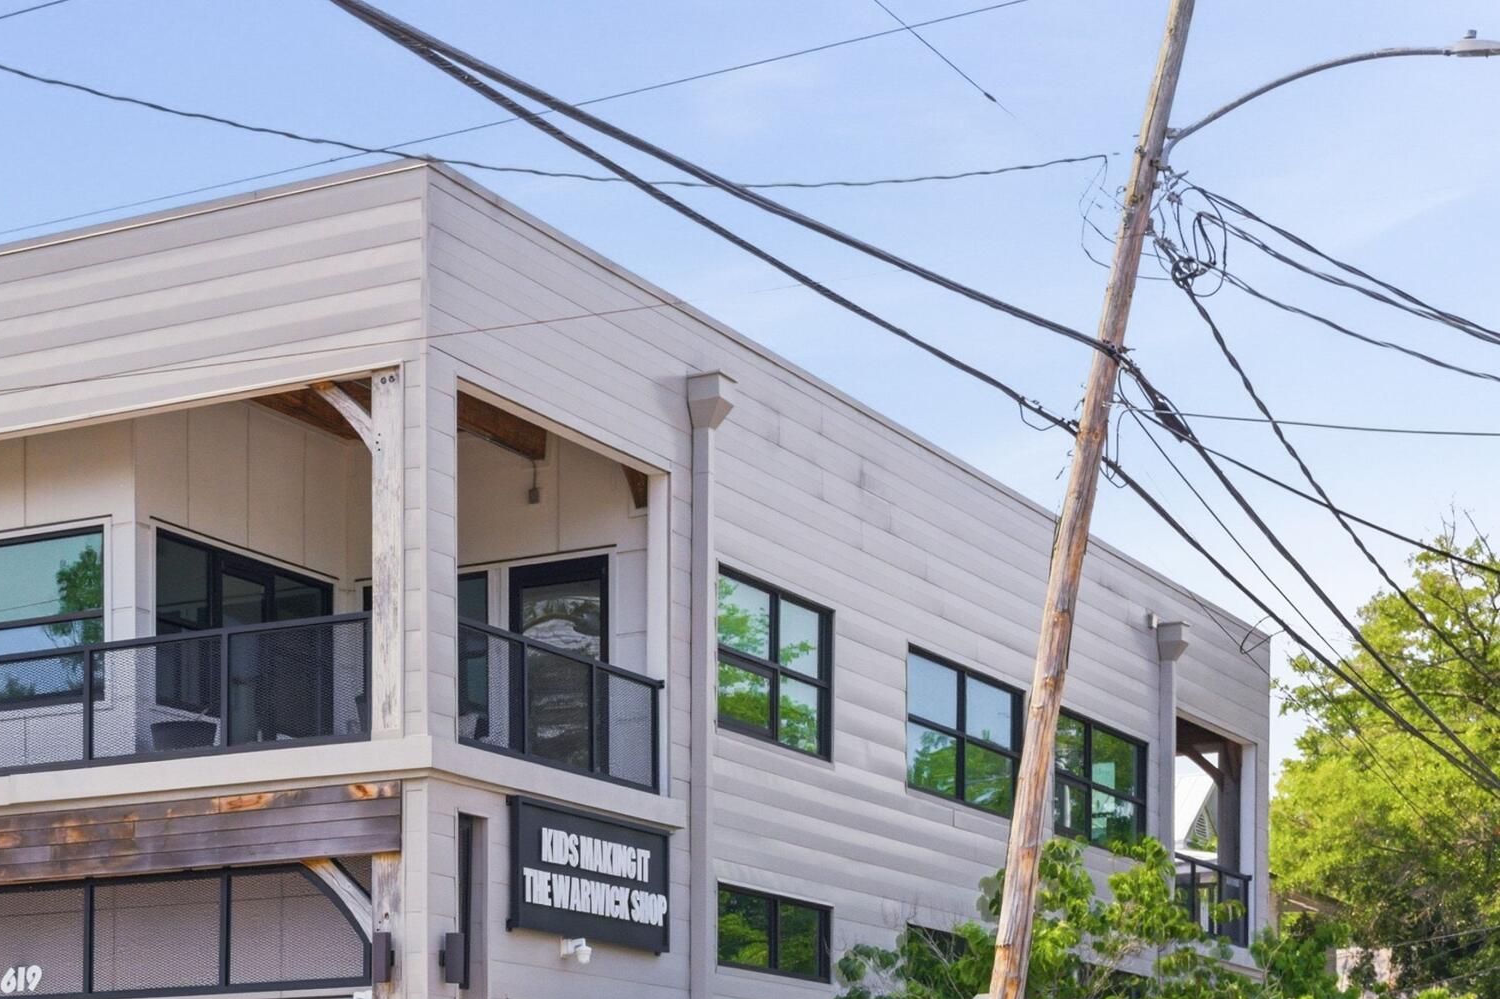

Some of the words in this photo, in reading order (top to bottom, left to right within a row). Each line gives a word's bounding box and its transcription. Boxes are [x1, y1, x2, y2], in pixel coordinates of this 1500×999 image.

[541, 827, 580, 868] KIDS
[579, 835, 637, 880] MAKING
[636, 848, 651, 883] IT
[523, 867, 552, 907] THE
[551, 873, 631, 921] WARWICK
[630, 889, 668, 927] SHOP
[0, 964, 43, 994] 619
